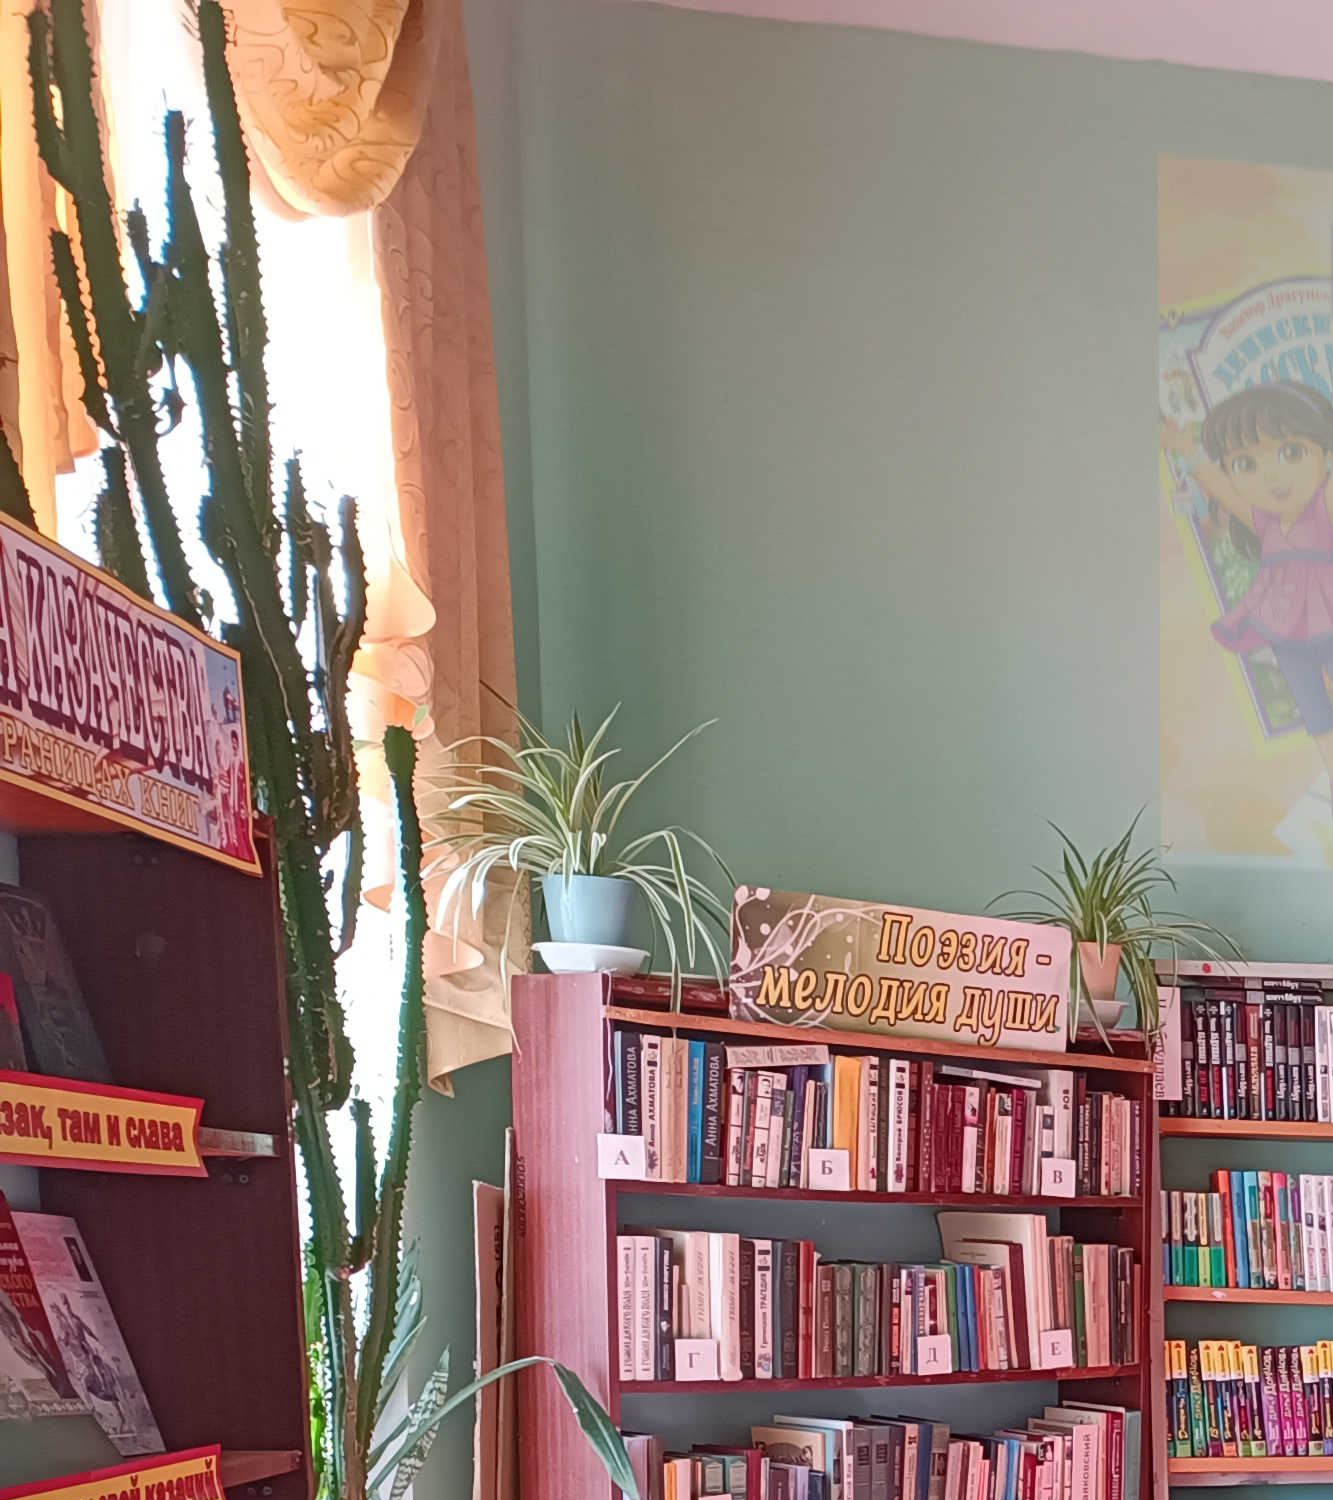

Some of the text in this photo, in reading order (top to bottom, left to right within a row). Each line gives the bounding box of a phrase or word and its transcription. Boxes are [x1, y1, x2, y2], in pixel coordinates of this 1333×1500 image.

[16, 552, 212, 788] КАЗАЧЕСТВА
[140, 774, 202, 835] КНИГ
[877, 912, 1030, 978] Поэзия
[953, 985, 1060, 1046] души
[626, 1047, 638, 1105] АХМАТОВА
[705, 1056, 719, 1146] АННА АХМАТОВА
[58, 1107, 101, 1144] там
[107, 1115, 120, 1134] и
[125, 1117, 184, 1152] слава
[614, 1150, 630, 1165] А
[821, 1160, 834, 1175] Б
[1053, 1171, 1062, 1184] В
[688, 1352, 700, 1368] Г
[926, 1347, 939, 1364] Д
[1051, 1342, 1061, 1356] Е
